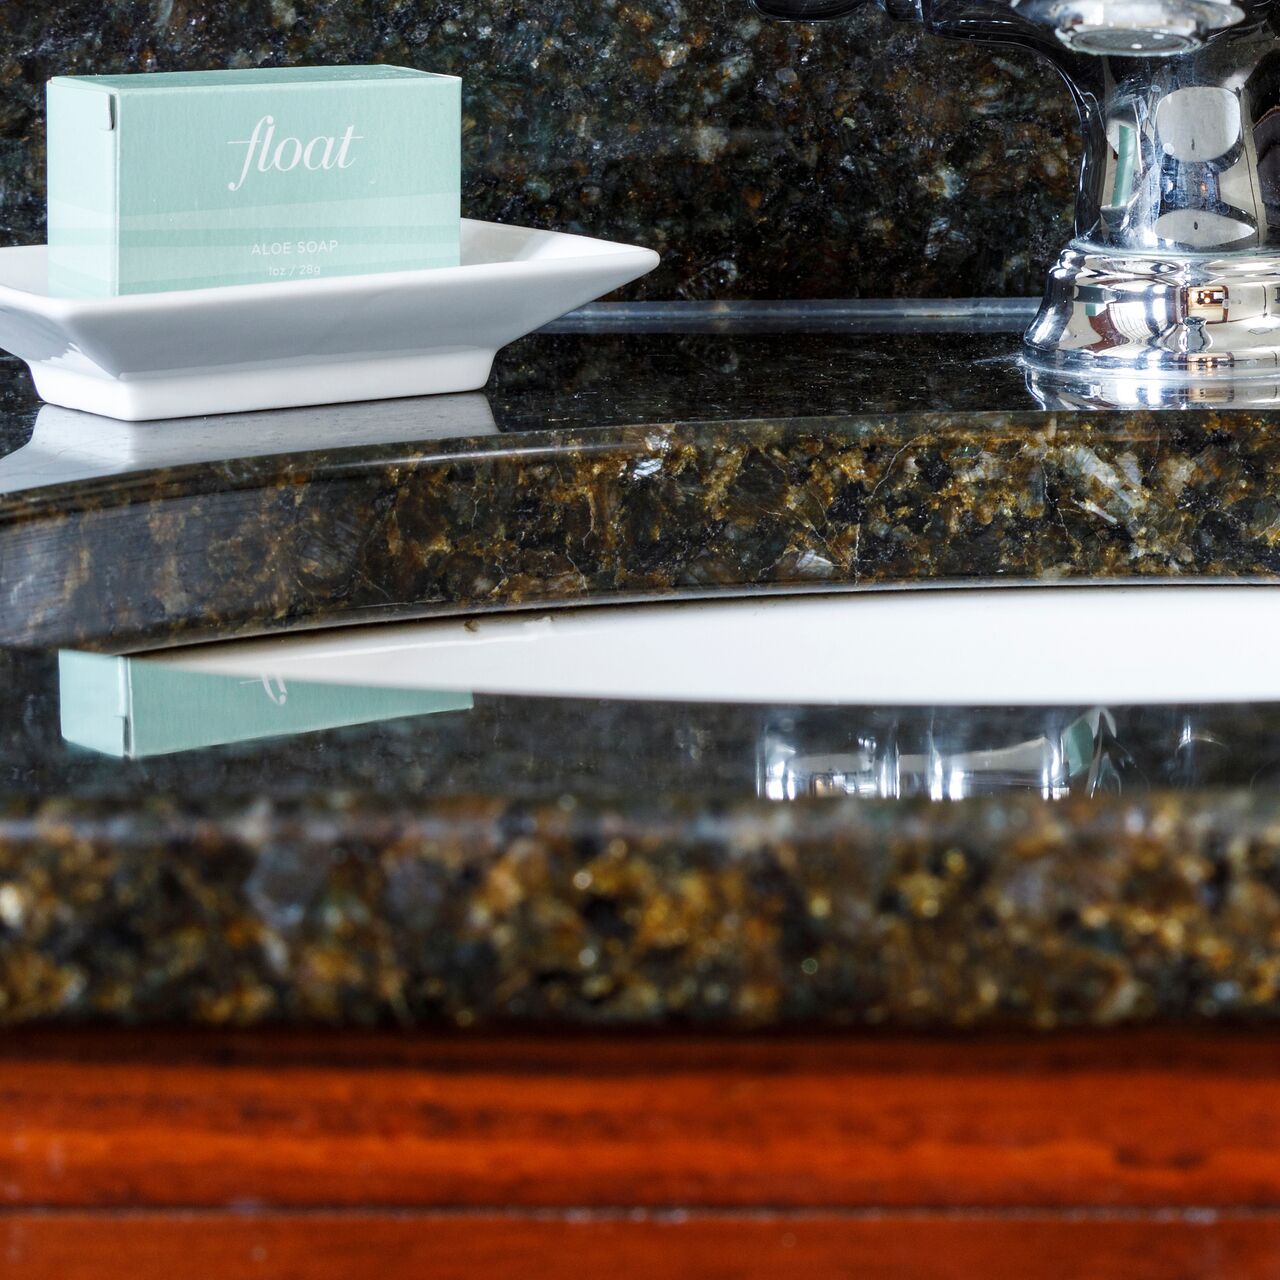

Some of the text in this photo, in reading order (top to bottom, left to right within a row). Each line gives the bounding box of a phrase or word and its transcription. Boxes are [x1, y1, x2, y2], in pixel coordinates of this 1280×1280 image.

[227, 115, 364, 191] float
[251, 240, 338, 255] ALOE SOAP
[299, 264, 321, 277] 28g
